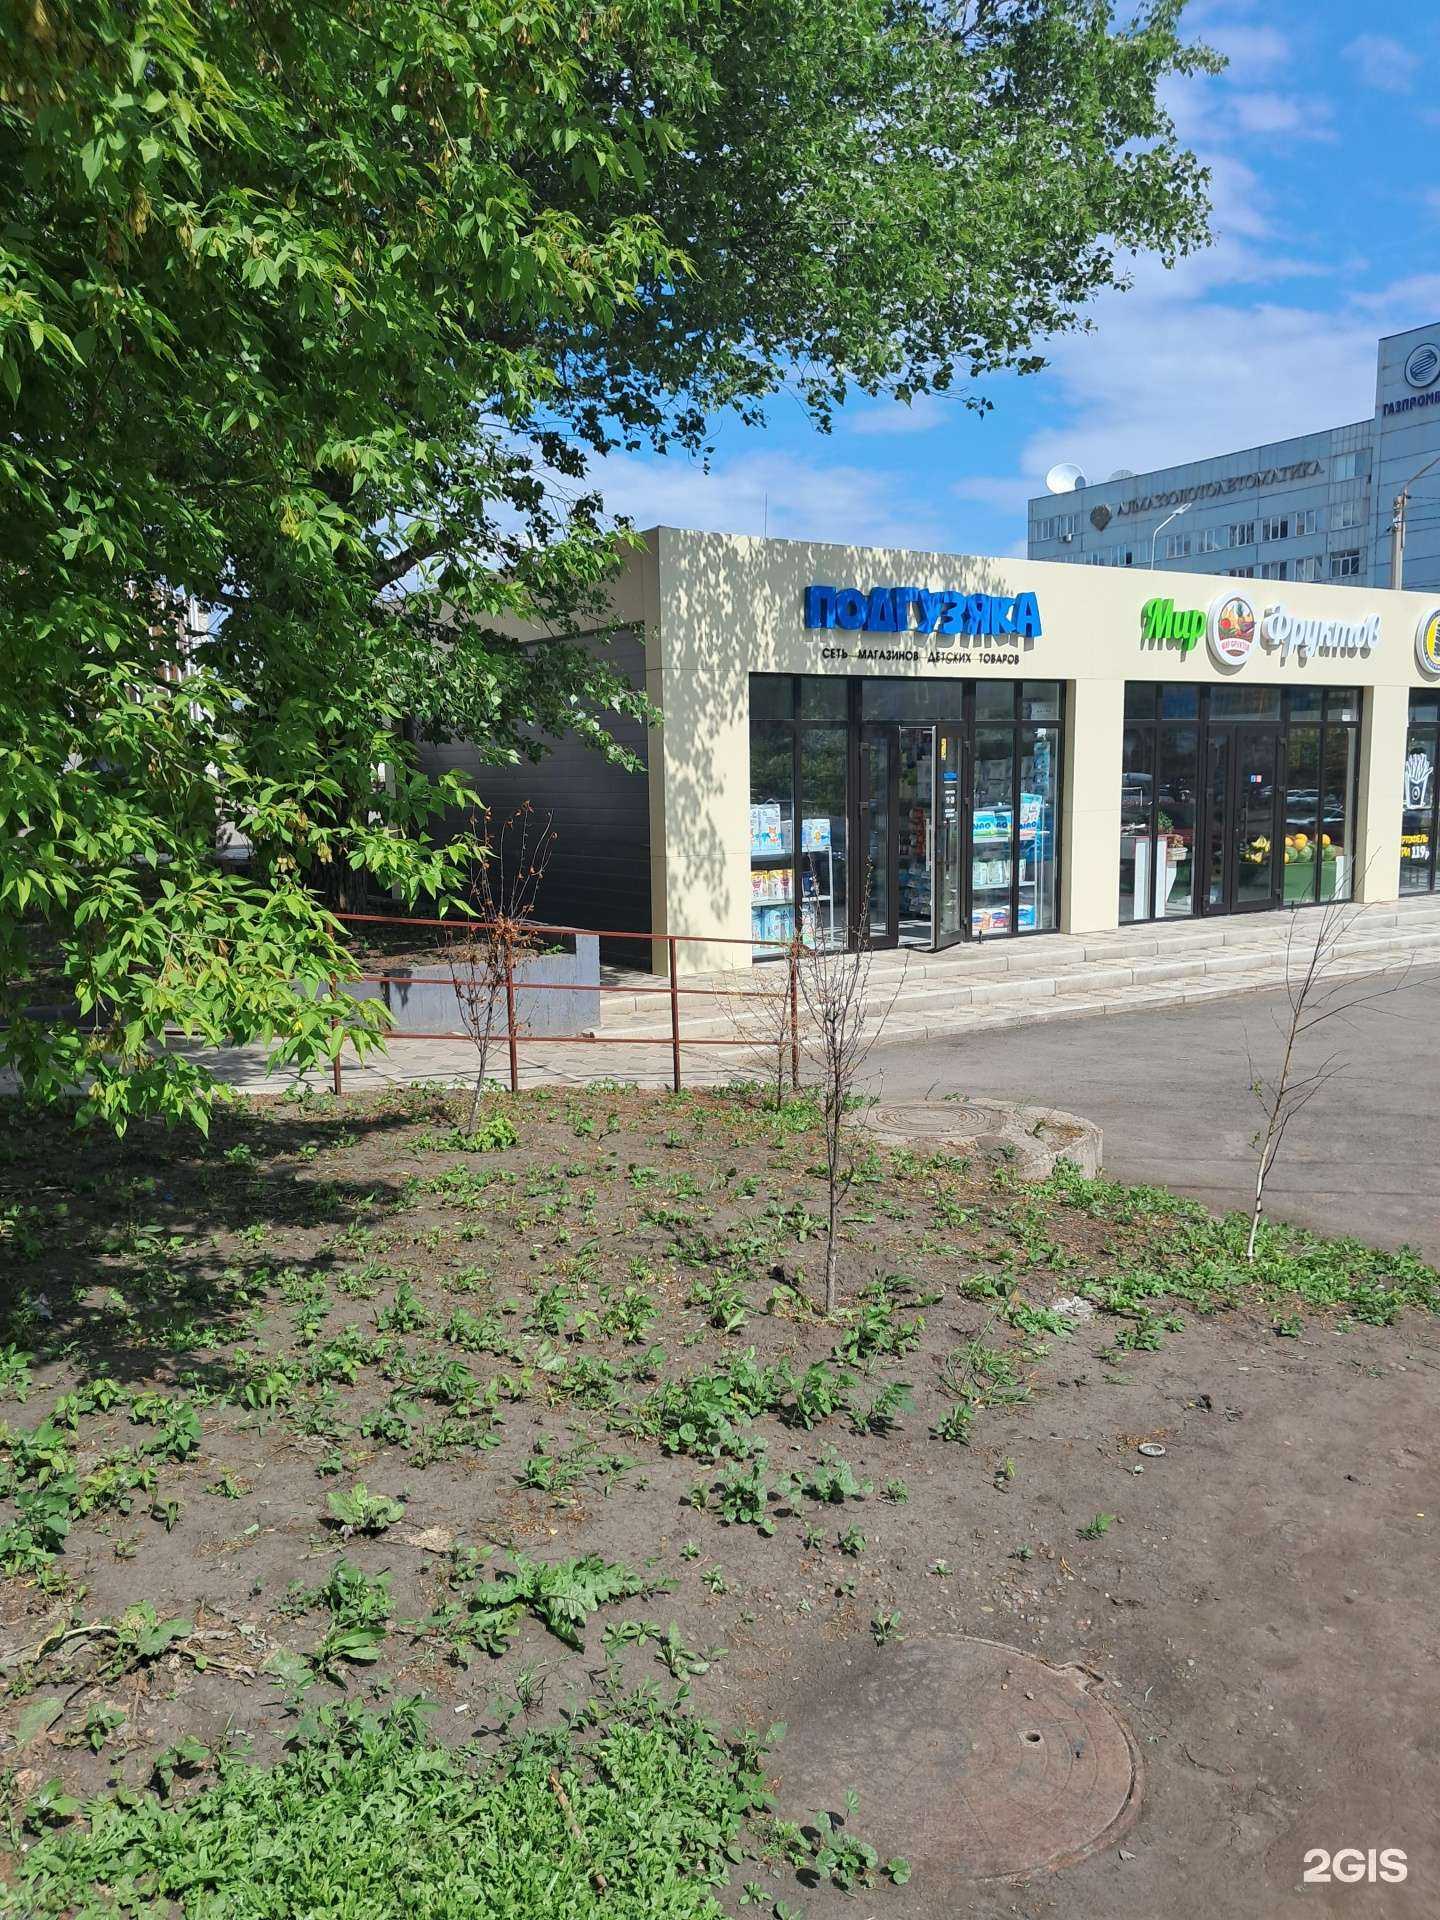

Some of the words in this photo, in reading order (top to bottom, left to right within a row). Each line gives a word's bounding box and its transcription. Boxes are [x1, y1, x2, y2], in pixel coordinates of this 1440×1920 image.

[804, 585, 1042, 638] ПОДГУЗЯКА
[1141, 598, 1206, 652] Мир
[1264, 604, 1382, 658] Фруктов
[822, 647, 848, 659] СЕТЬ
[858, 649, 919, 662] МАГАЗИНОВ
[927, 651, 972, 664] ДЕТСКИХ
[979, 653, 1020, 666] ТОВАРОВ
